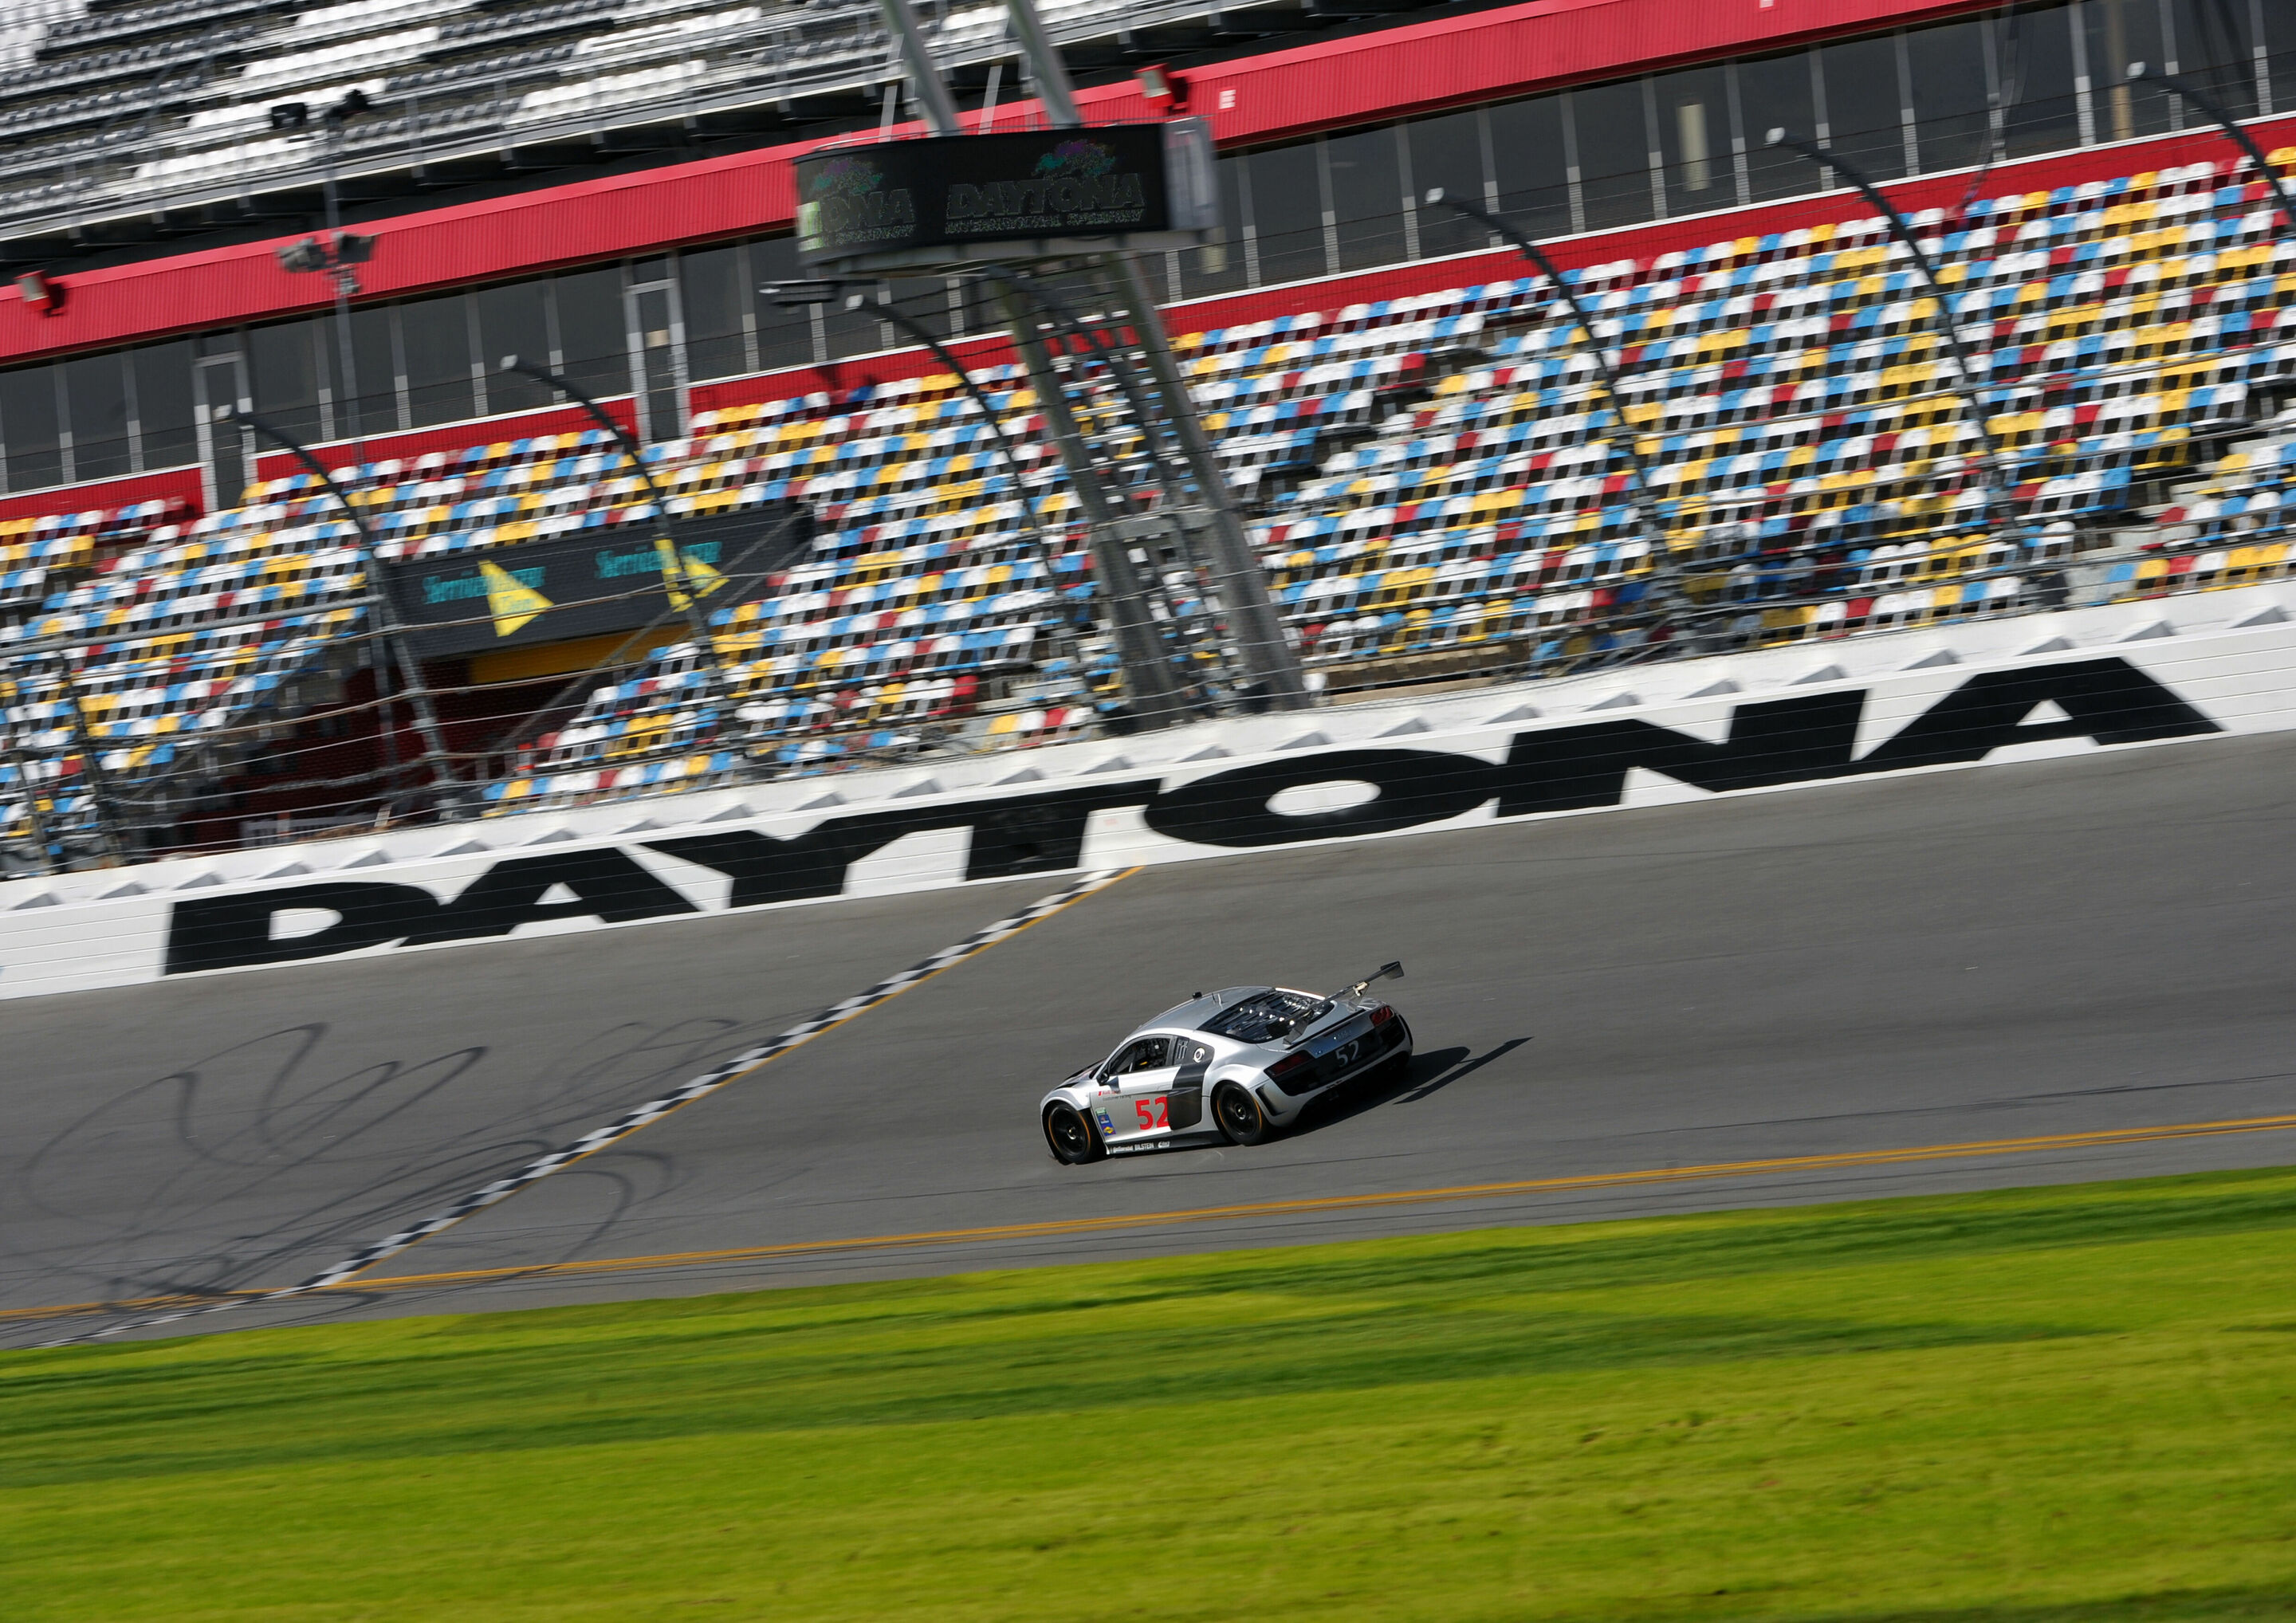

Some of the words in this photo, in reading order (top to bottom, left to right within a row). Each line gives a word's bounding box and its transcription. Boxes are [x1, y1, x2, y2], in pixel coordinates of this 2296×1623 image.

[946, 173, 1146, 221] DAYTONA
[163, 657, 2225, 975] DAYTONA
[1335, 1040, 1359, 1067] 52
[1135, 1096, 1169, 1130] 52
